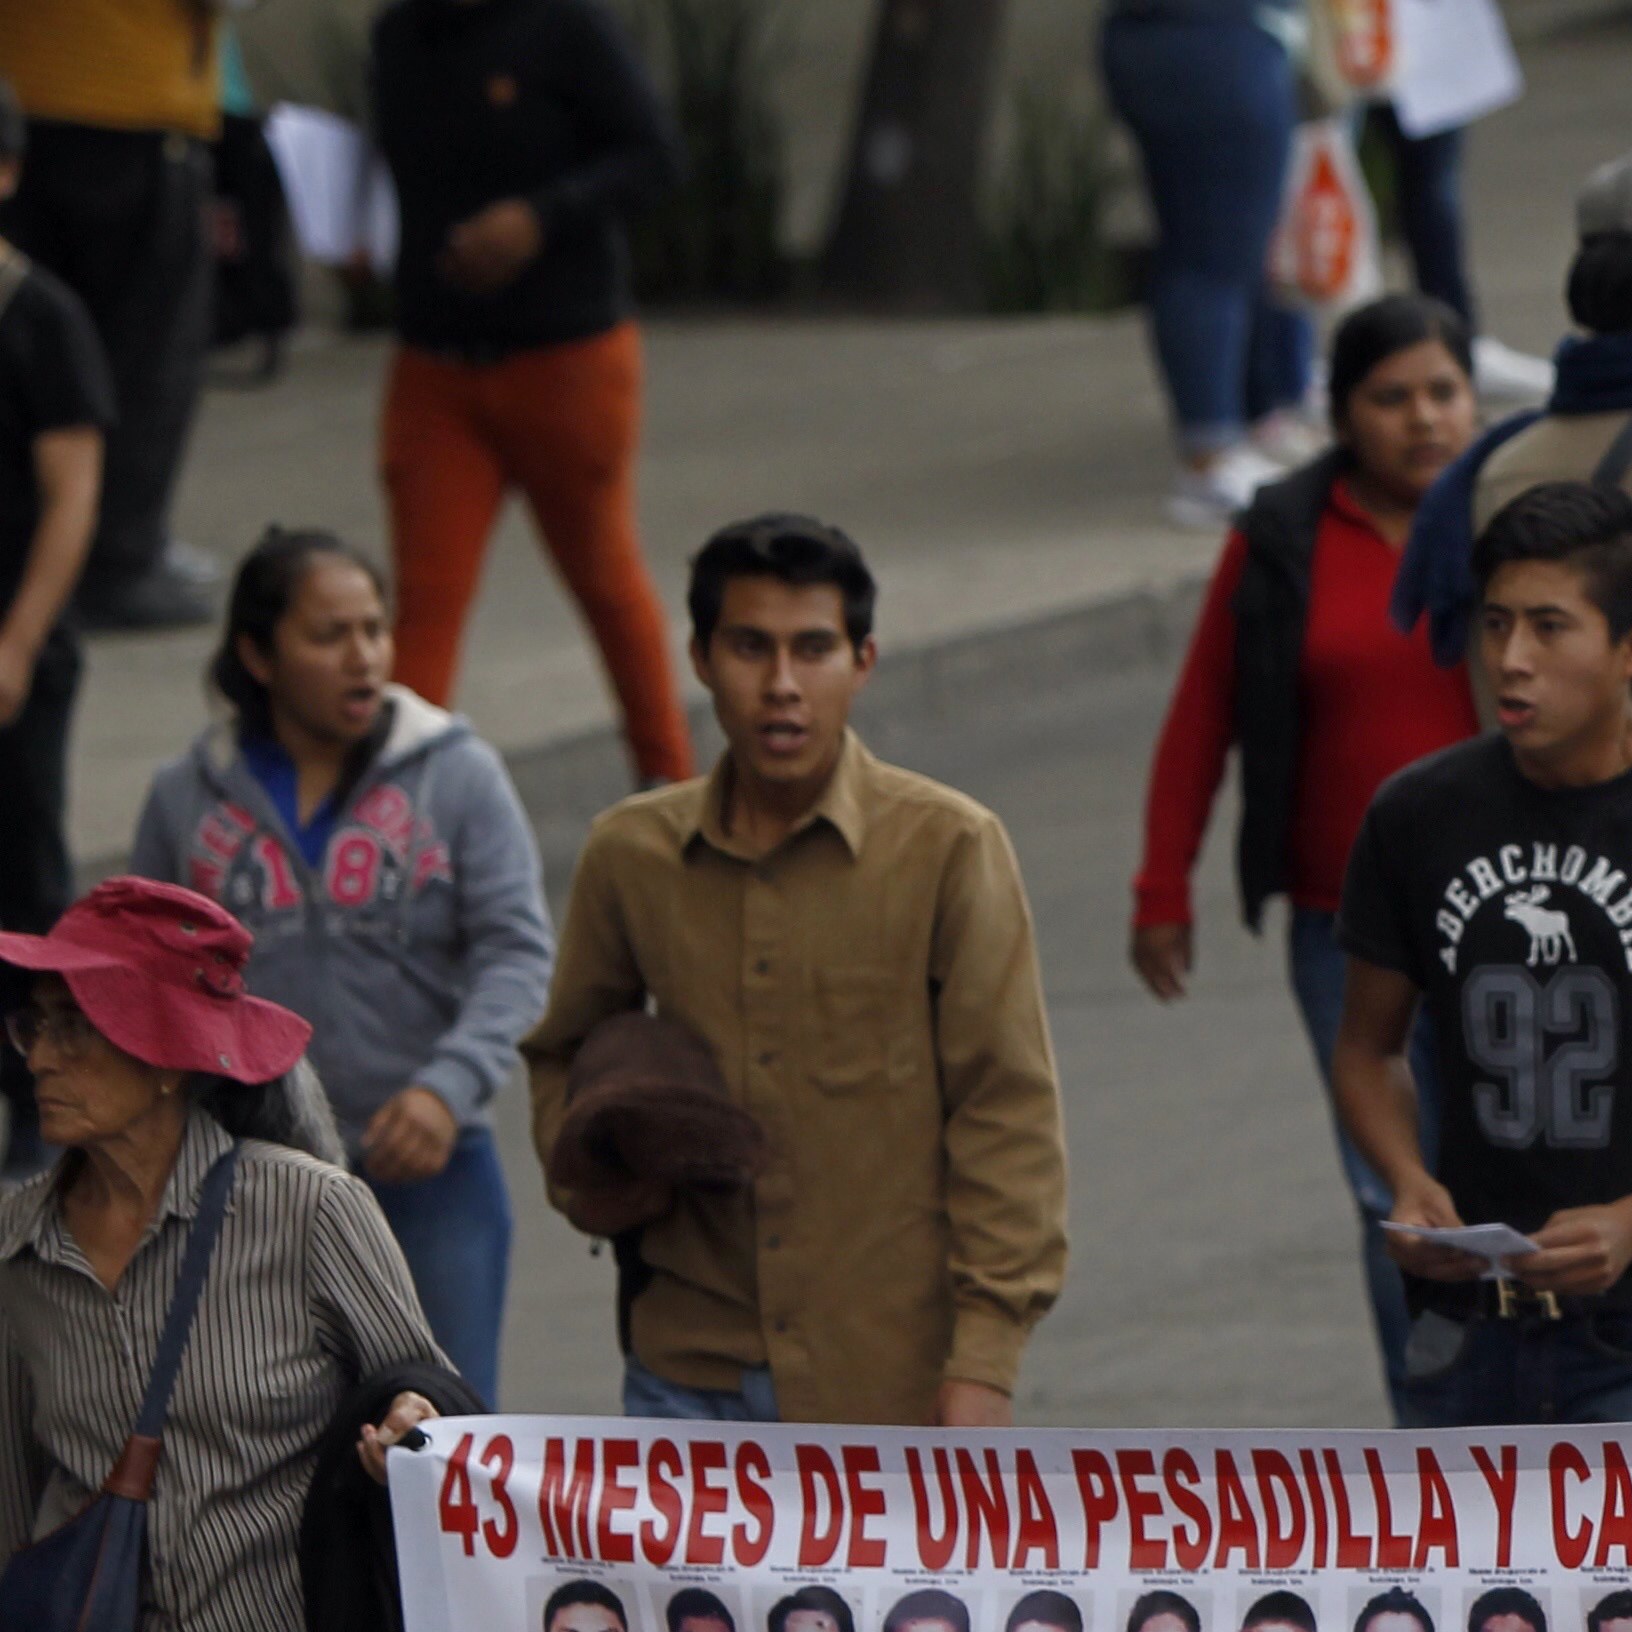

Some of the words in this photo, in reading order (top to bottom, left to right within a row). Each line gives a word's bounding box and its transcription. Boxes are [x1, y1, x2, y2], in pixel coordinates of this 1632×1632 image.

[1461, 963, 1620, 1150] 92
[438, 1434, 519, 1559] 43
[538, 1438, 774, 1568] MESES
[795, 1445, 887, 1568] DE
[905, 1448, 1058, 1571] UNA
[1070, 1449, 1459, 1571] PESADILLA
[1470, 1446, 1518, 1569] Y
